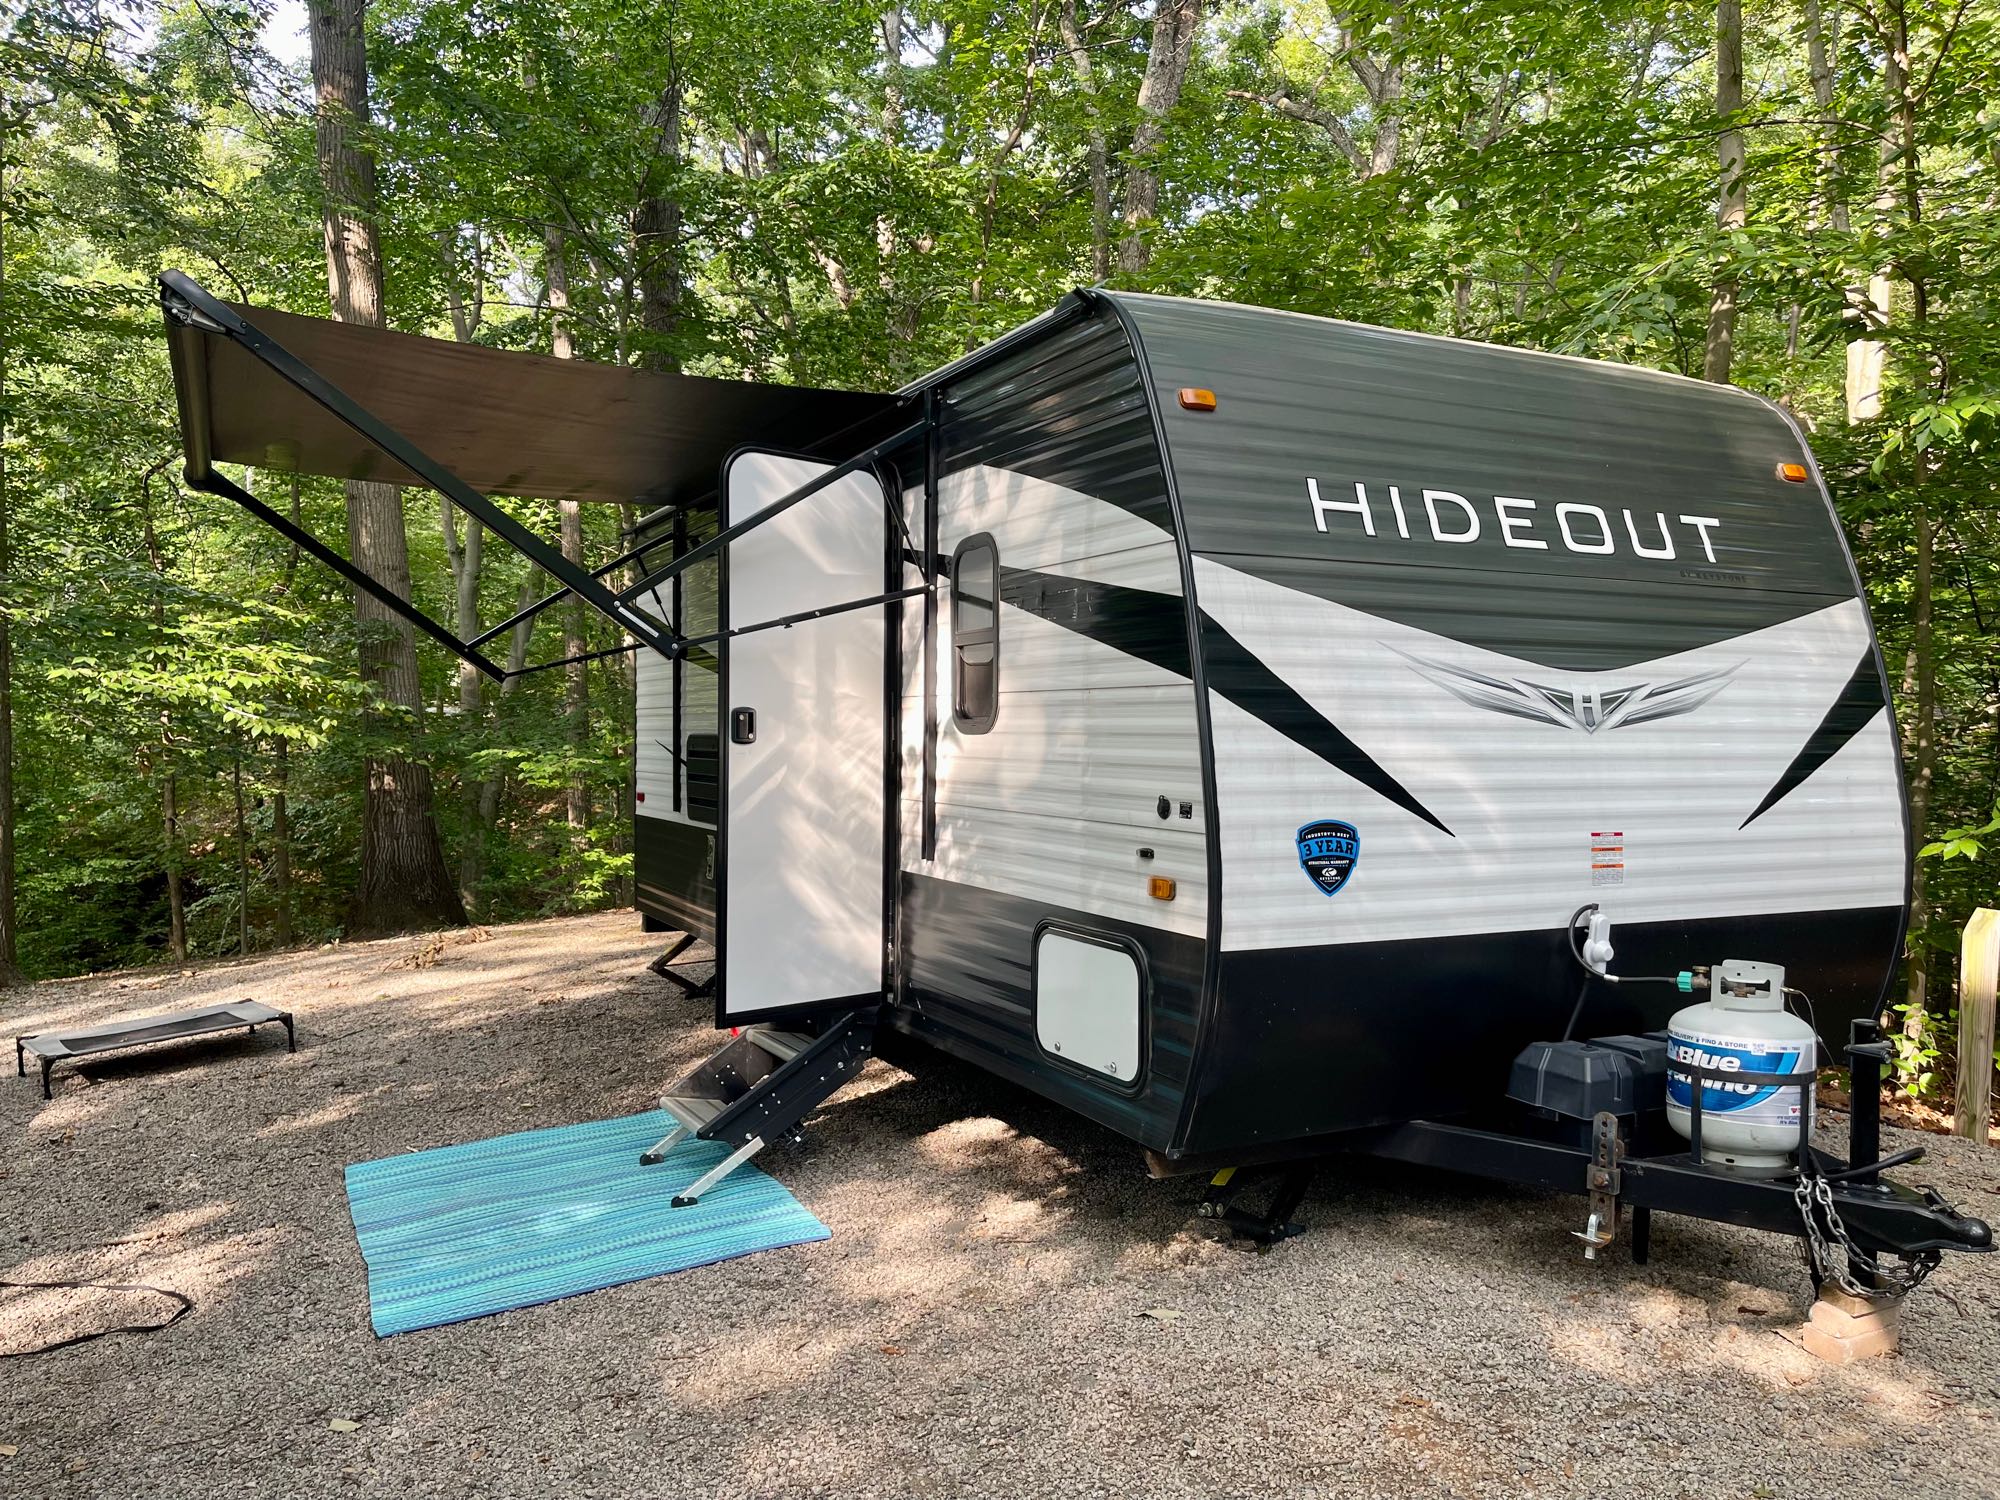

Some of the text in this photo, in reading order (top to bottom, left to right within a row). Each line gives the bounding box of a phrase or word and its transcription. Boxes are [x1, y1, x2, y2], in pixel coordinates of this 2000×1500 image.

[1305, 477, 1721, 564] HIDEOUT
[1303, 840, 1354, 856] 3 YEAR
[1724, 1041, 1749, 1049] STORE
[1679, 1045, 1741, 1073] Blue
